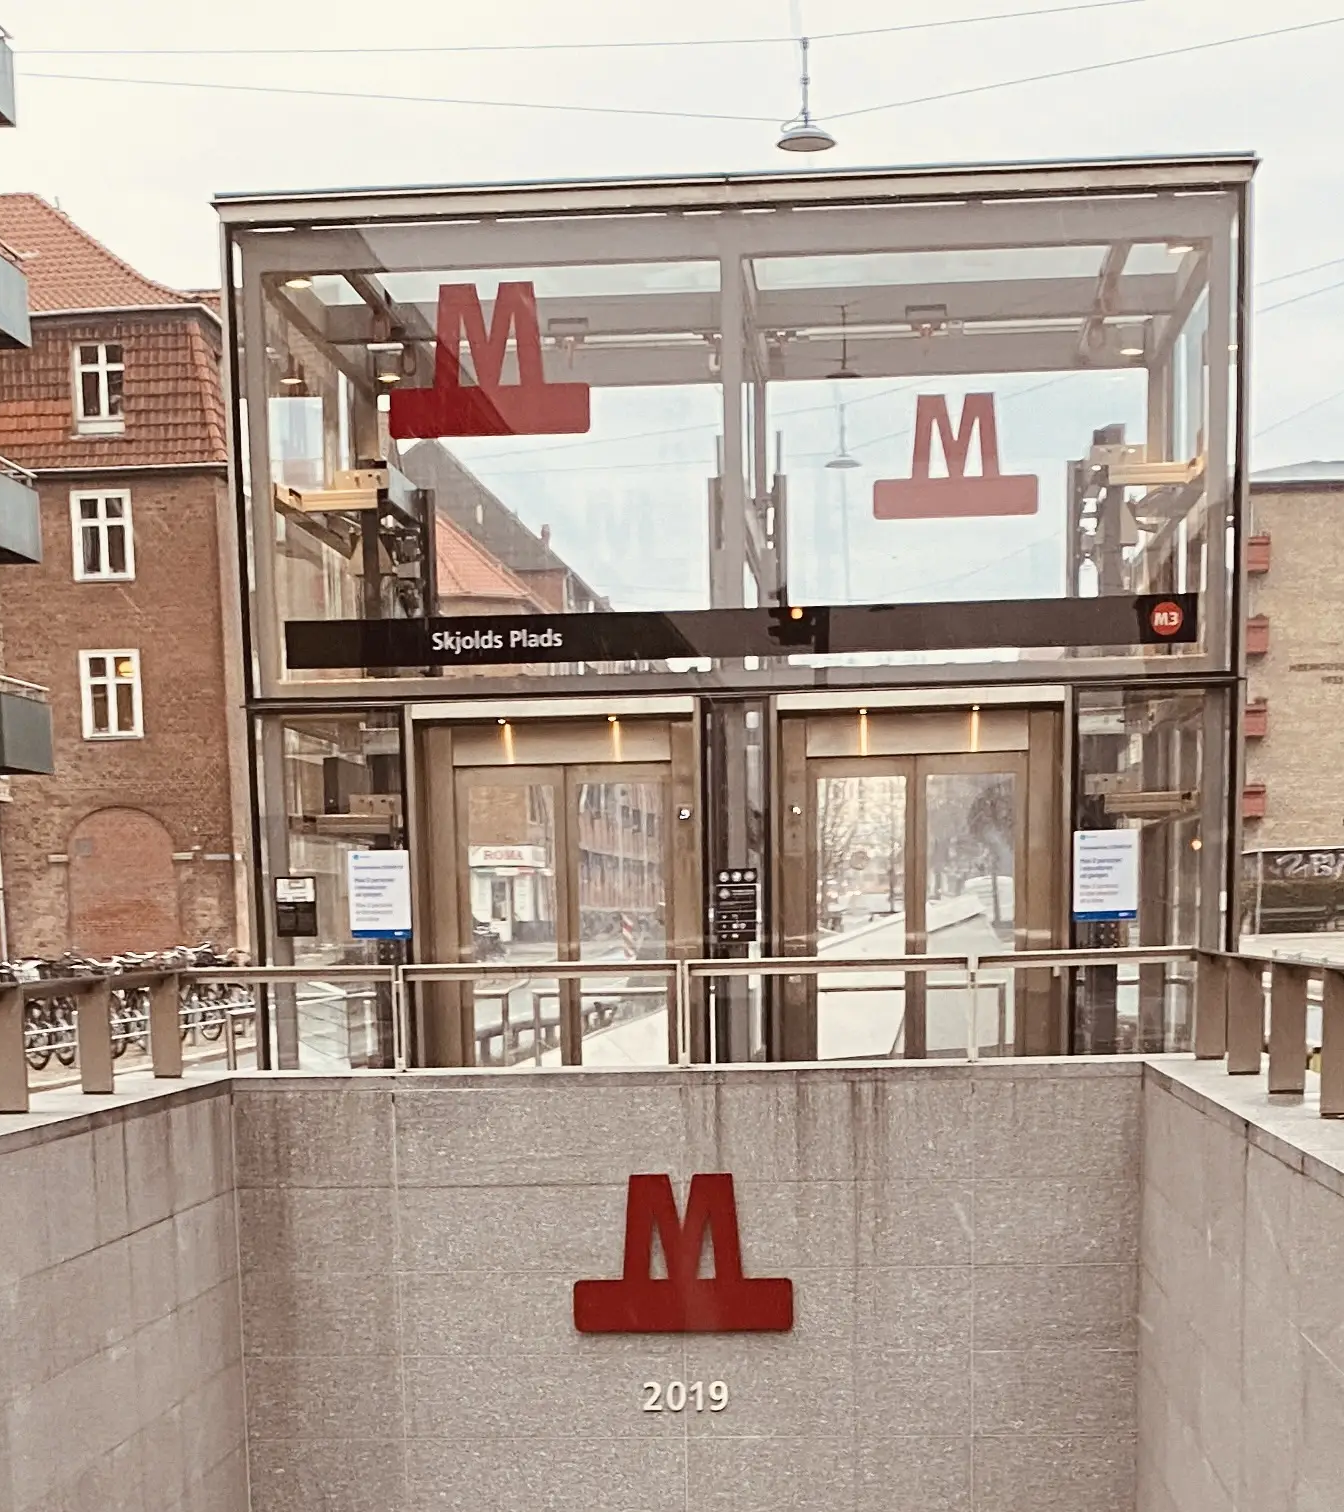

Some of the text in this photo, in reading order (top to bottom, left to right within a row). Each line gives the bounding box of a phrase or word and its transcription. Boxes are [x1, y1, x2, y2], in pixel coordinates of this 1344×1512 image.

[1154, 612, 1179, 626] M3
[431, 627, 563, 655] Skjolds Plads
[483, 850, 524, 861] ROMA
[643, 1380, 730, 1413] 2019
